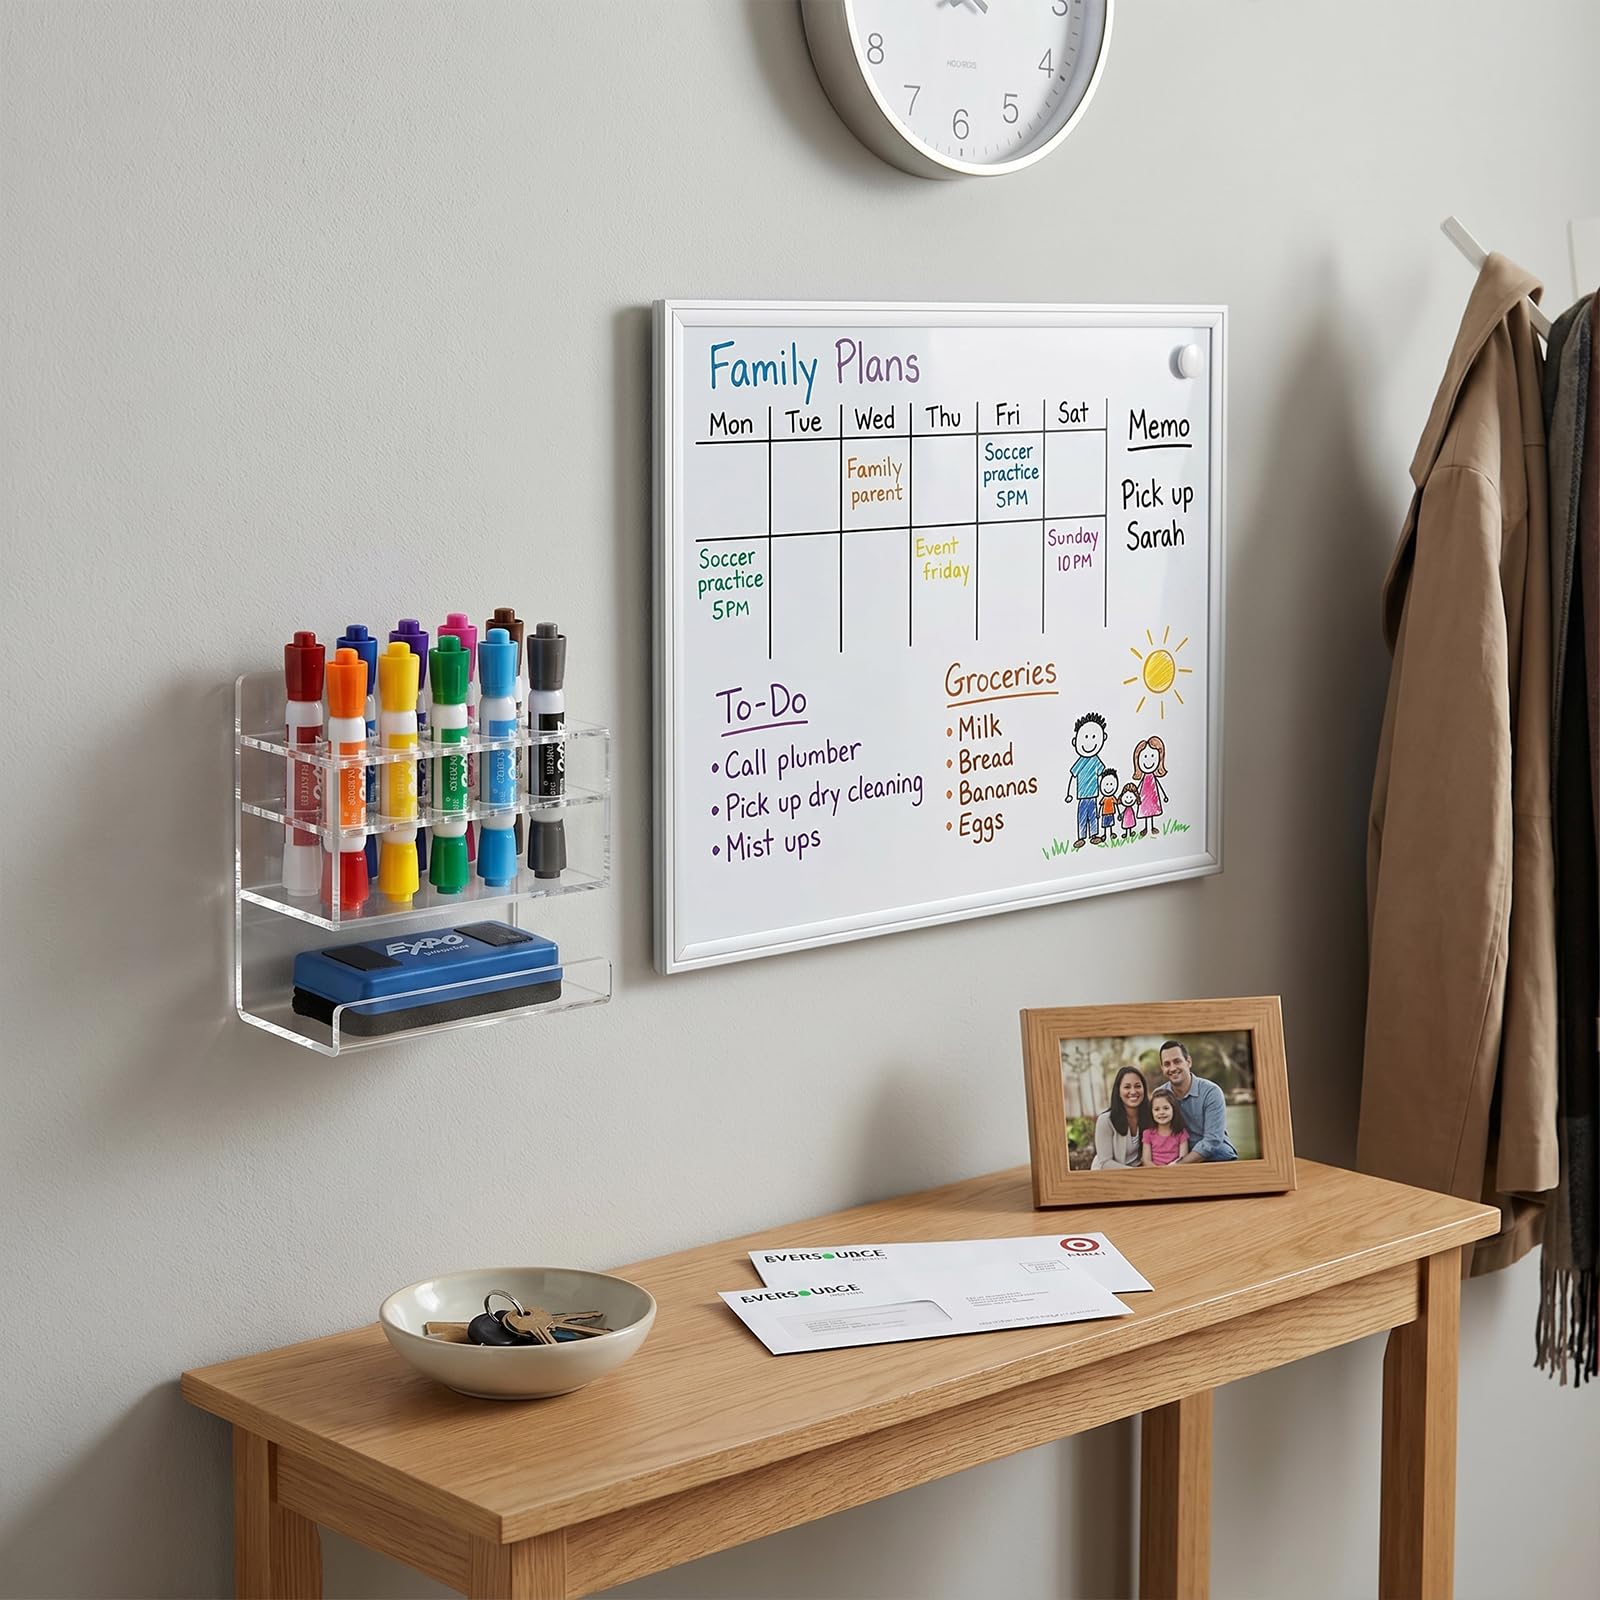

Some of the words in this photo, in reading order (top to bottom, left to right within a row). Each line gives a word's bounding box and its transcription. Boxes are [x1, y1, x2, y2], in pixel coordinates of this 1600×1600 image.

[867, 33, 884, 64] 8
[1038, 48, 1055, 79] 4
[904, 85, 920, 116] 7
[1003, 93, 1018, 123] 5
[953, 109, 969, 139] 6
[711, 341, 817, 405] Family
[835, 338, 919, 384] Plans
[710, 412, 752, 436] Mon
[785, 410, 822, 433] Tue
[855, 405, 894, 430] Wed
[925, 405, 960, 427] Thu
[997, 403, 1019, 425] Fri
[1058, 401, 1089, 423] Sat
[1129, 409, 1189, 440] Memo
[985, 443, 1033, 461] Soccer
[848, 456, 902, 483] Family
[984, 463, 1039, 487] practice
[852, 484, 902, 510] parent
[997, 490, 1028, 508] 5PM
[1122, 478, 1163, 510] Pick
[1172, 487, 1193, 513] up
[916, 537, 959, 558] Event
[1048, 527, 1098, 551] Sunday
[1127, 519, 1184, 551] Sarah
[700, 548, 755, 569] Soccer
[923, 560, 969, 586] friday
[698, 570, 763, 600] practice
[713, 600, 749, 620] 5PM
[945, 661, 1057, 697] Groceries
[716, 683, 807, 723] To-Do
[960, 713, 1002, 741] Milk
[726, 749, 766, 778] Call
[778, 739, 862, 780] plumber
[959, 742, 1013, 774] Bread
[727, 792, 769, 821] Pick
[779, 795, 801, 819] up
[809, 781, 840, 816] dry
[848, 773, 922, 806] cleaning
[960, 777, 1037, 805] Bananas
[960, 812, 1004, 844] Eggs
[727, 829, 774, 862] Mist
[785, 830, 820, 860] ups
[385, 934, 464, 957] EXPO
